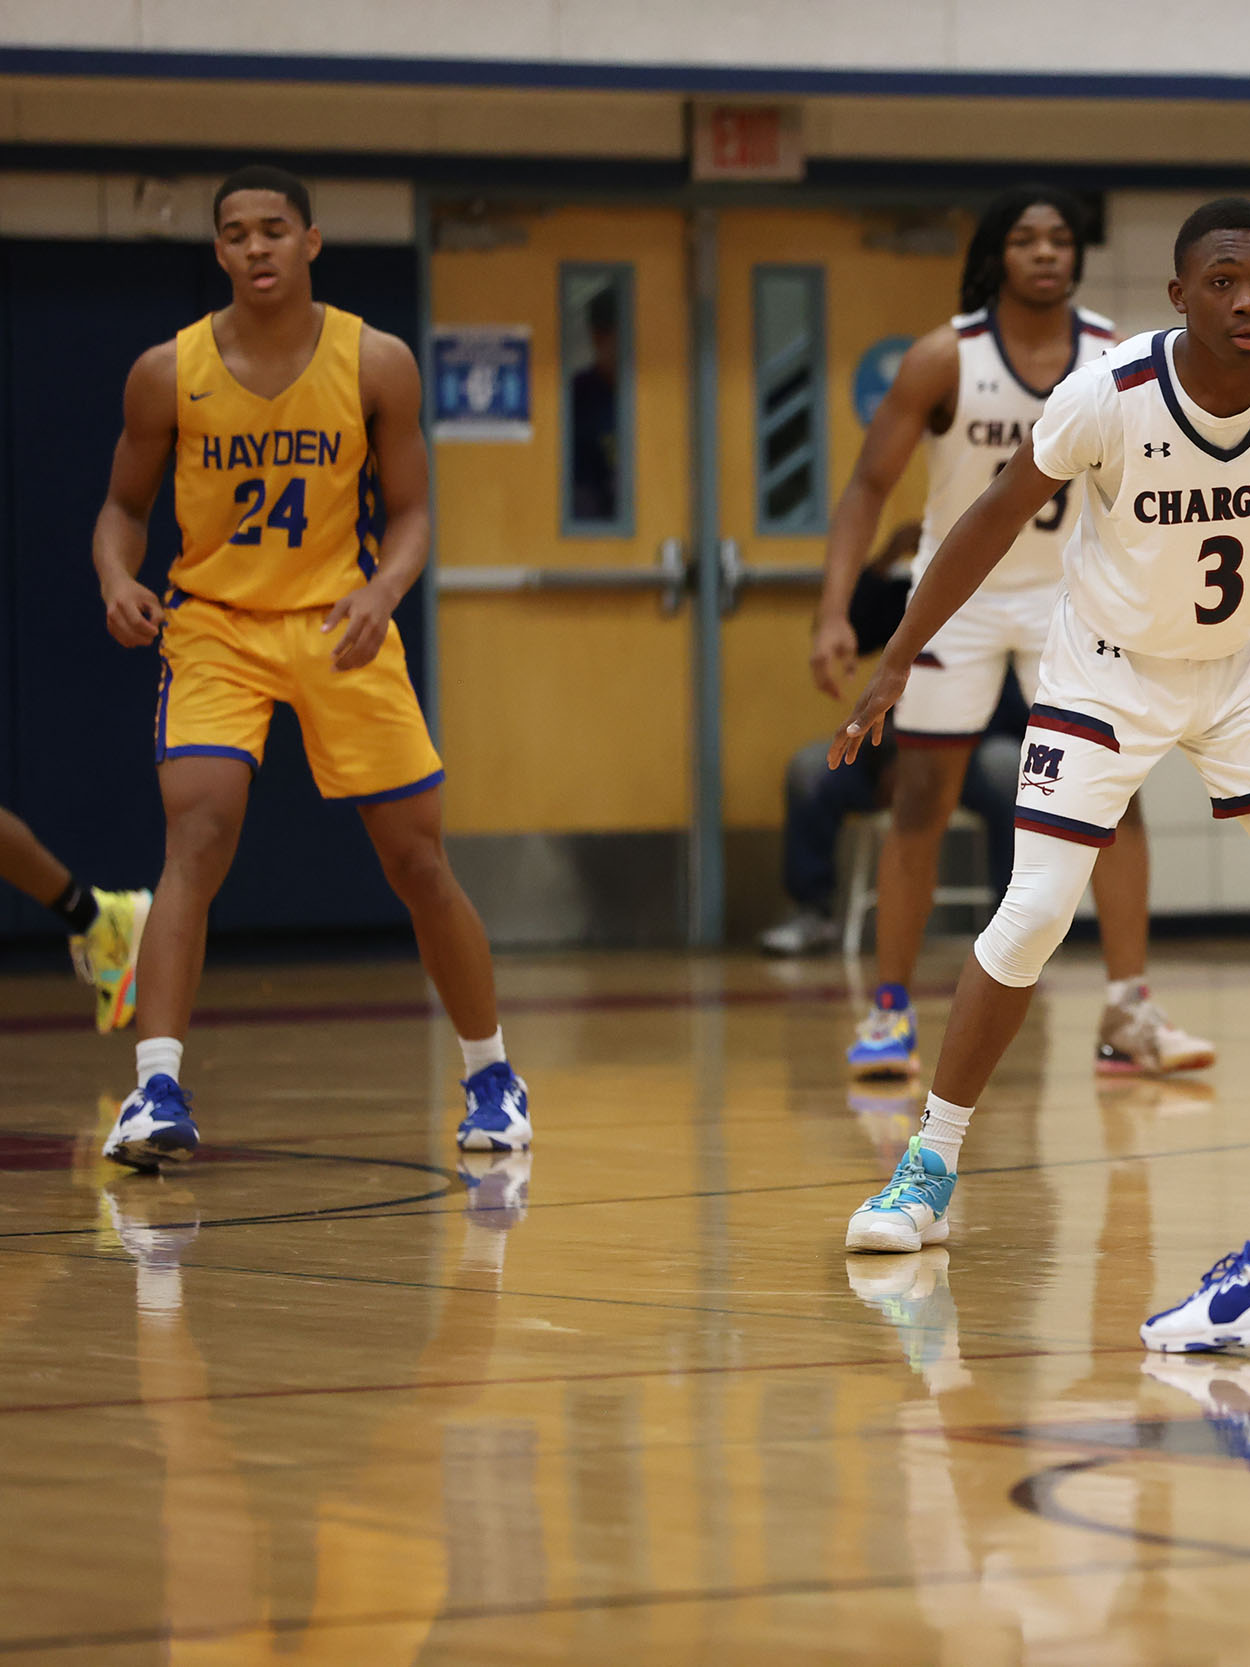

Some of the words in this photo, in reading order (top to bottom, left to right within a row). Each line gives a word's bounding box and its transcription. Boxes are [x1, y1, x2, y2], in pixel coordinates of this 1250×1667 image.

[202, 430, 341, 470] HAYDEN
[228, 477, 308, 548] 24
[1194, 535, 1244, 625] 3
